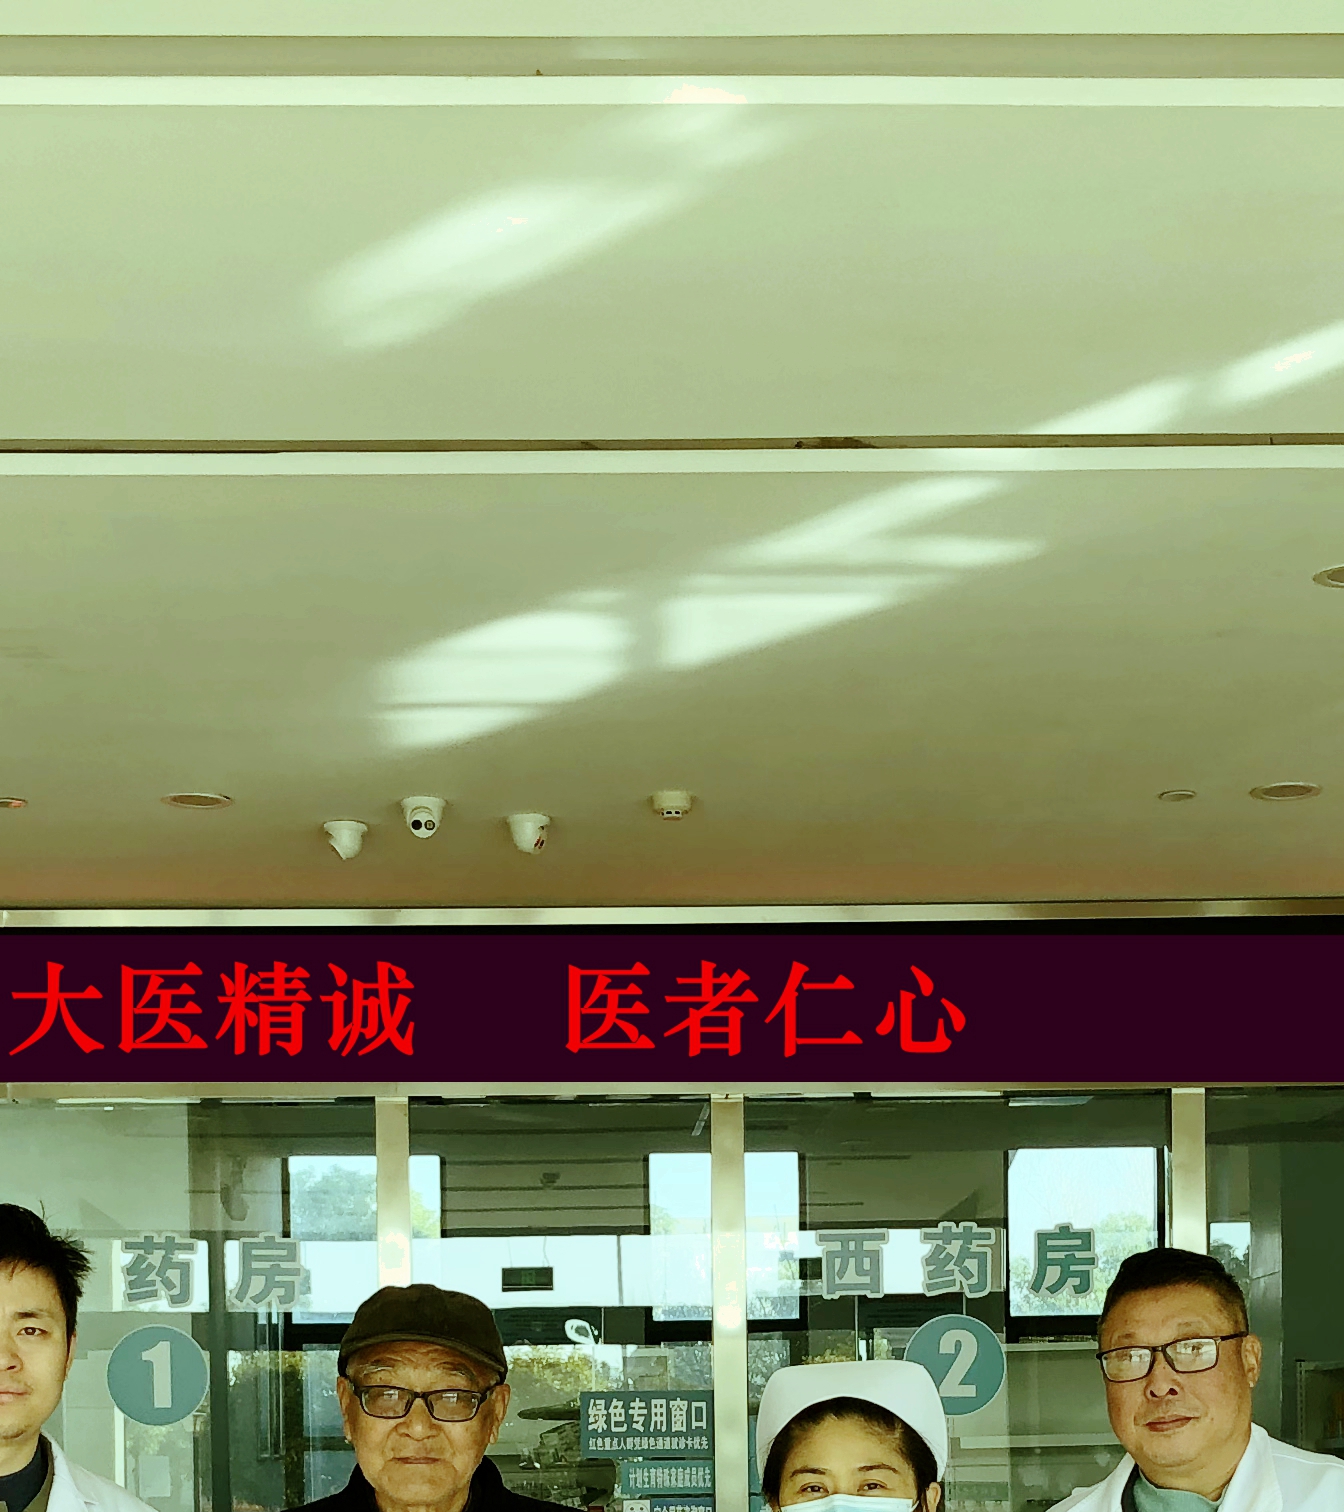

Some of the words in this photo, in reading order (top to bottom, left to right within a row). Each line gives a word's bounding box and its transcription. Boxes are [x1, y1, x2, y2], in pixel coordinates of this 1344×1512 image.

[10, 962, 414, 1056] 大医精诚
[566, 961, 965, 1057] 医者仁心
[122, 1234, 302, 1306] 药房
[816, 1222, 1098, 1299] 西药房
[142, 1340, 172, 1408] 1
[937, 1330, 977, 1398] 2
[587, 1397, 707, 1434] 绿色专用窗口
